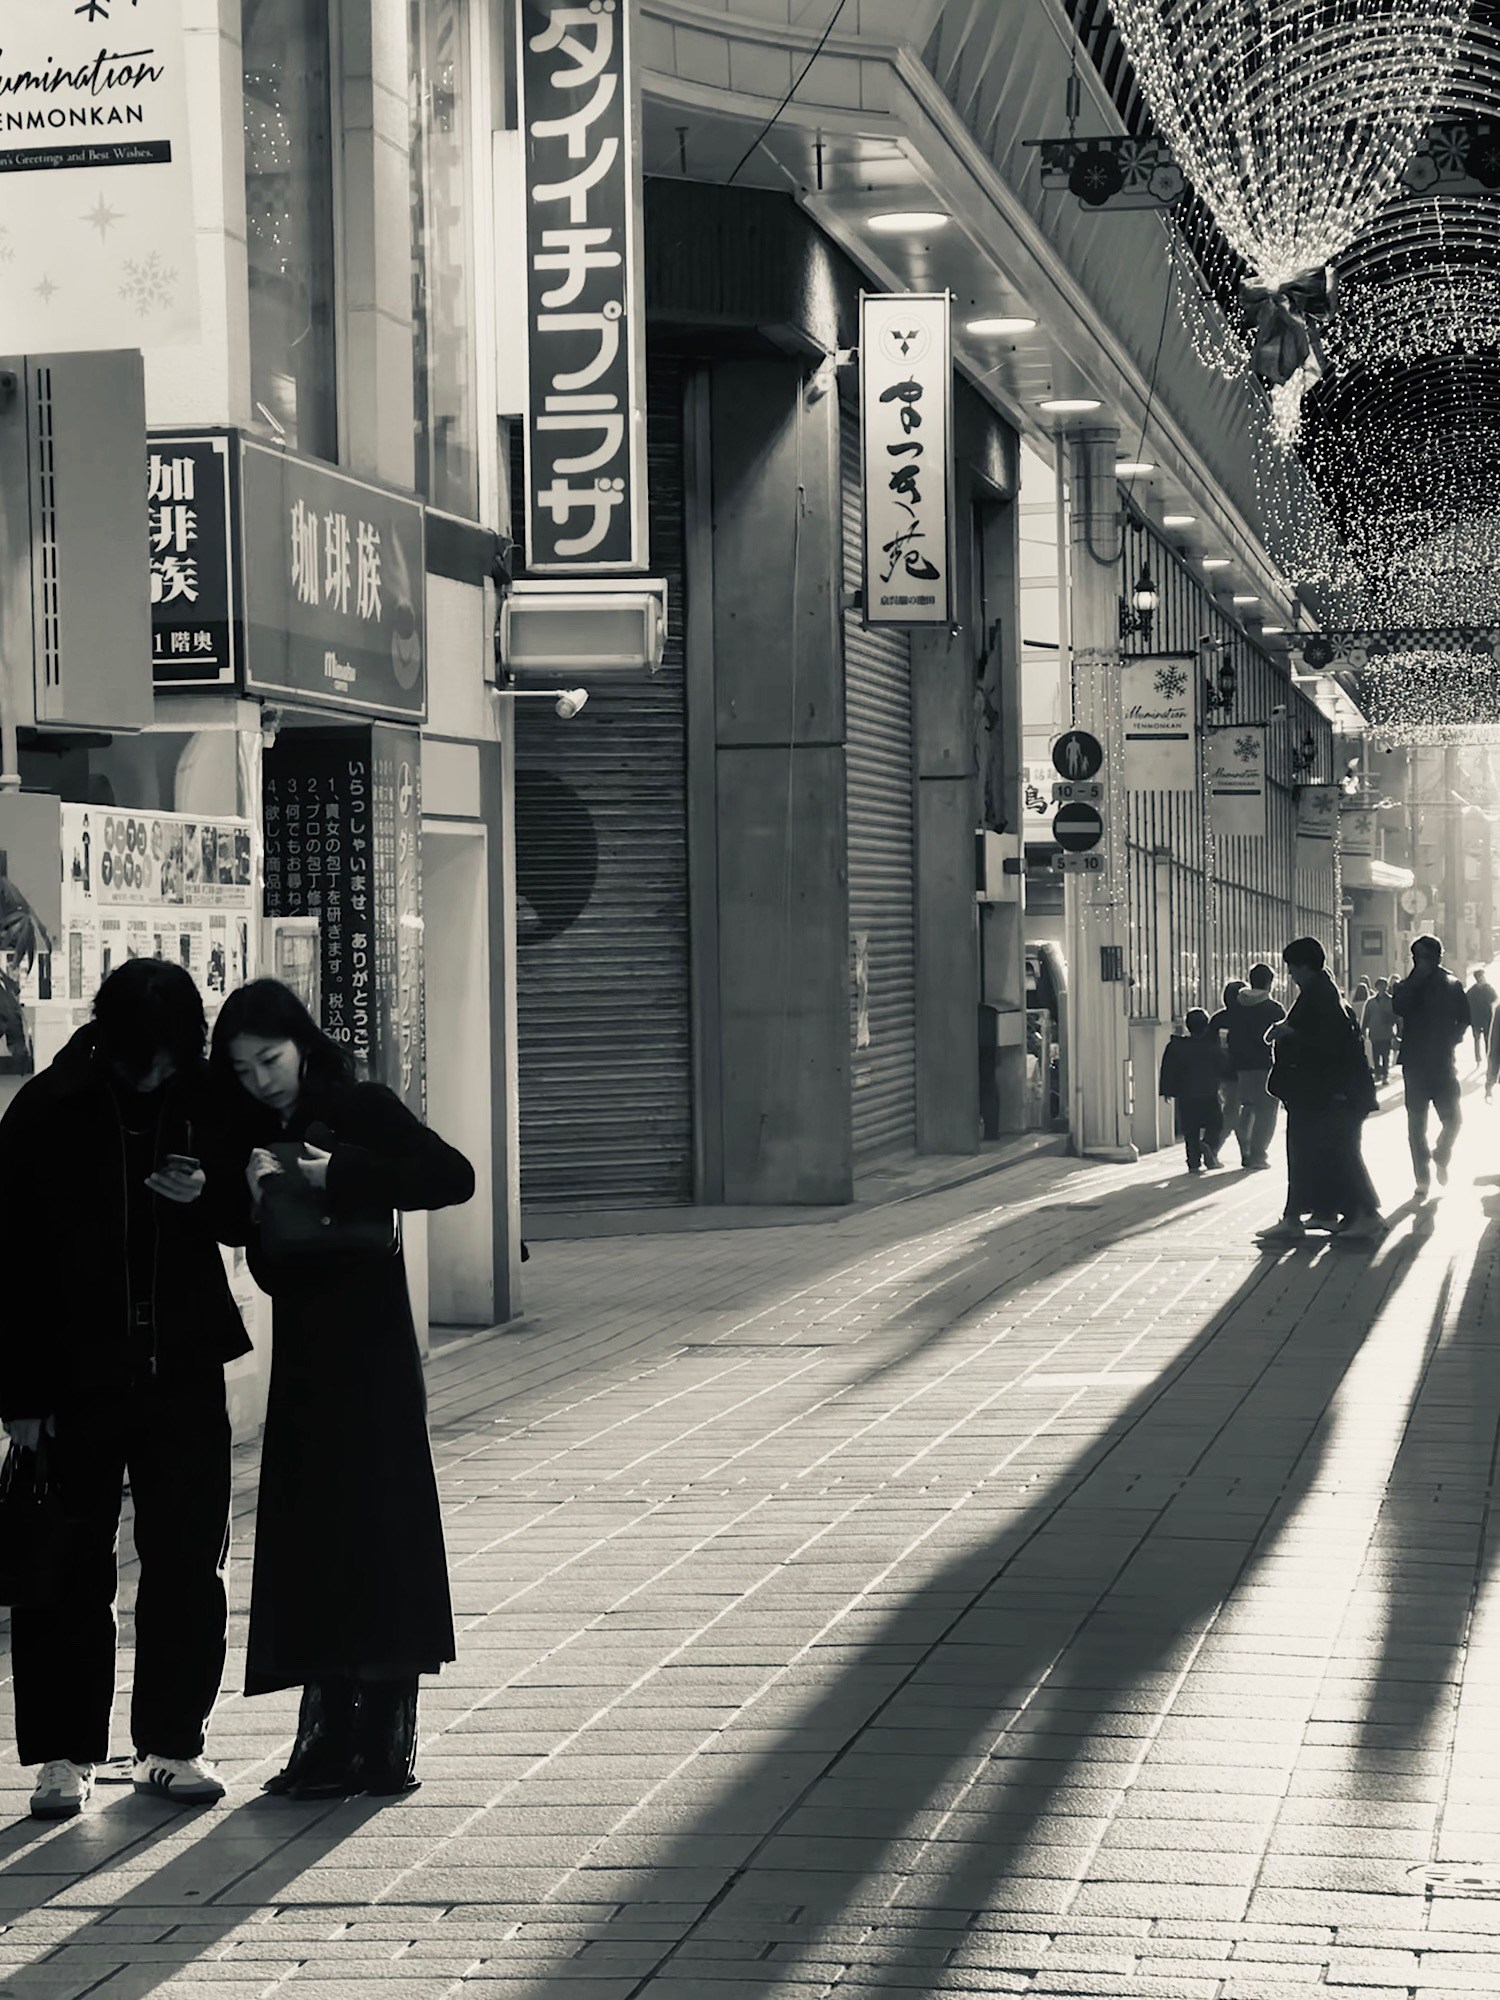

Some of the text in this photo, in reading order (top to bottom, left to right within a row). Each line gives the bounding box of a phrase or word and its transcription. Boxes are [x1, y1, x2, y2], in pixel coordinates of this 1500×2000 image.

[0, 48, 164, 96] umination
[0, 104, 143, 131] NMONKAN
[15, 152, 64, 166] Greetings
[66, 150, 86, 162] and
[88, 149, 109, 161] Best
[529, 0, 624, 557] ダイイチプラザ
[290, 498, 383, 623] 珈琲族
